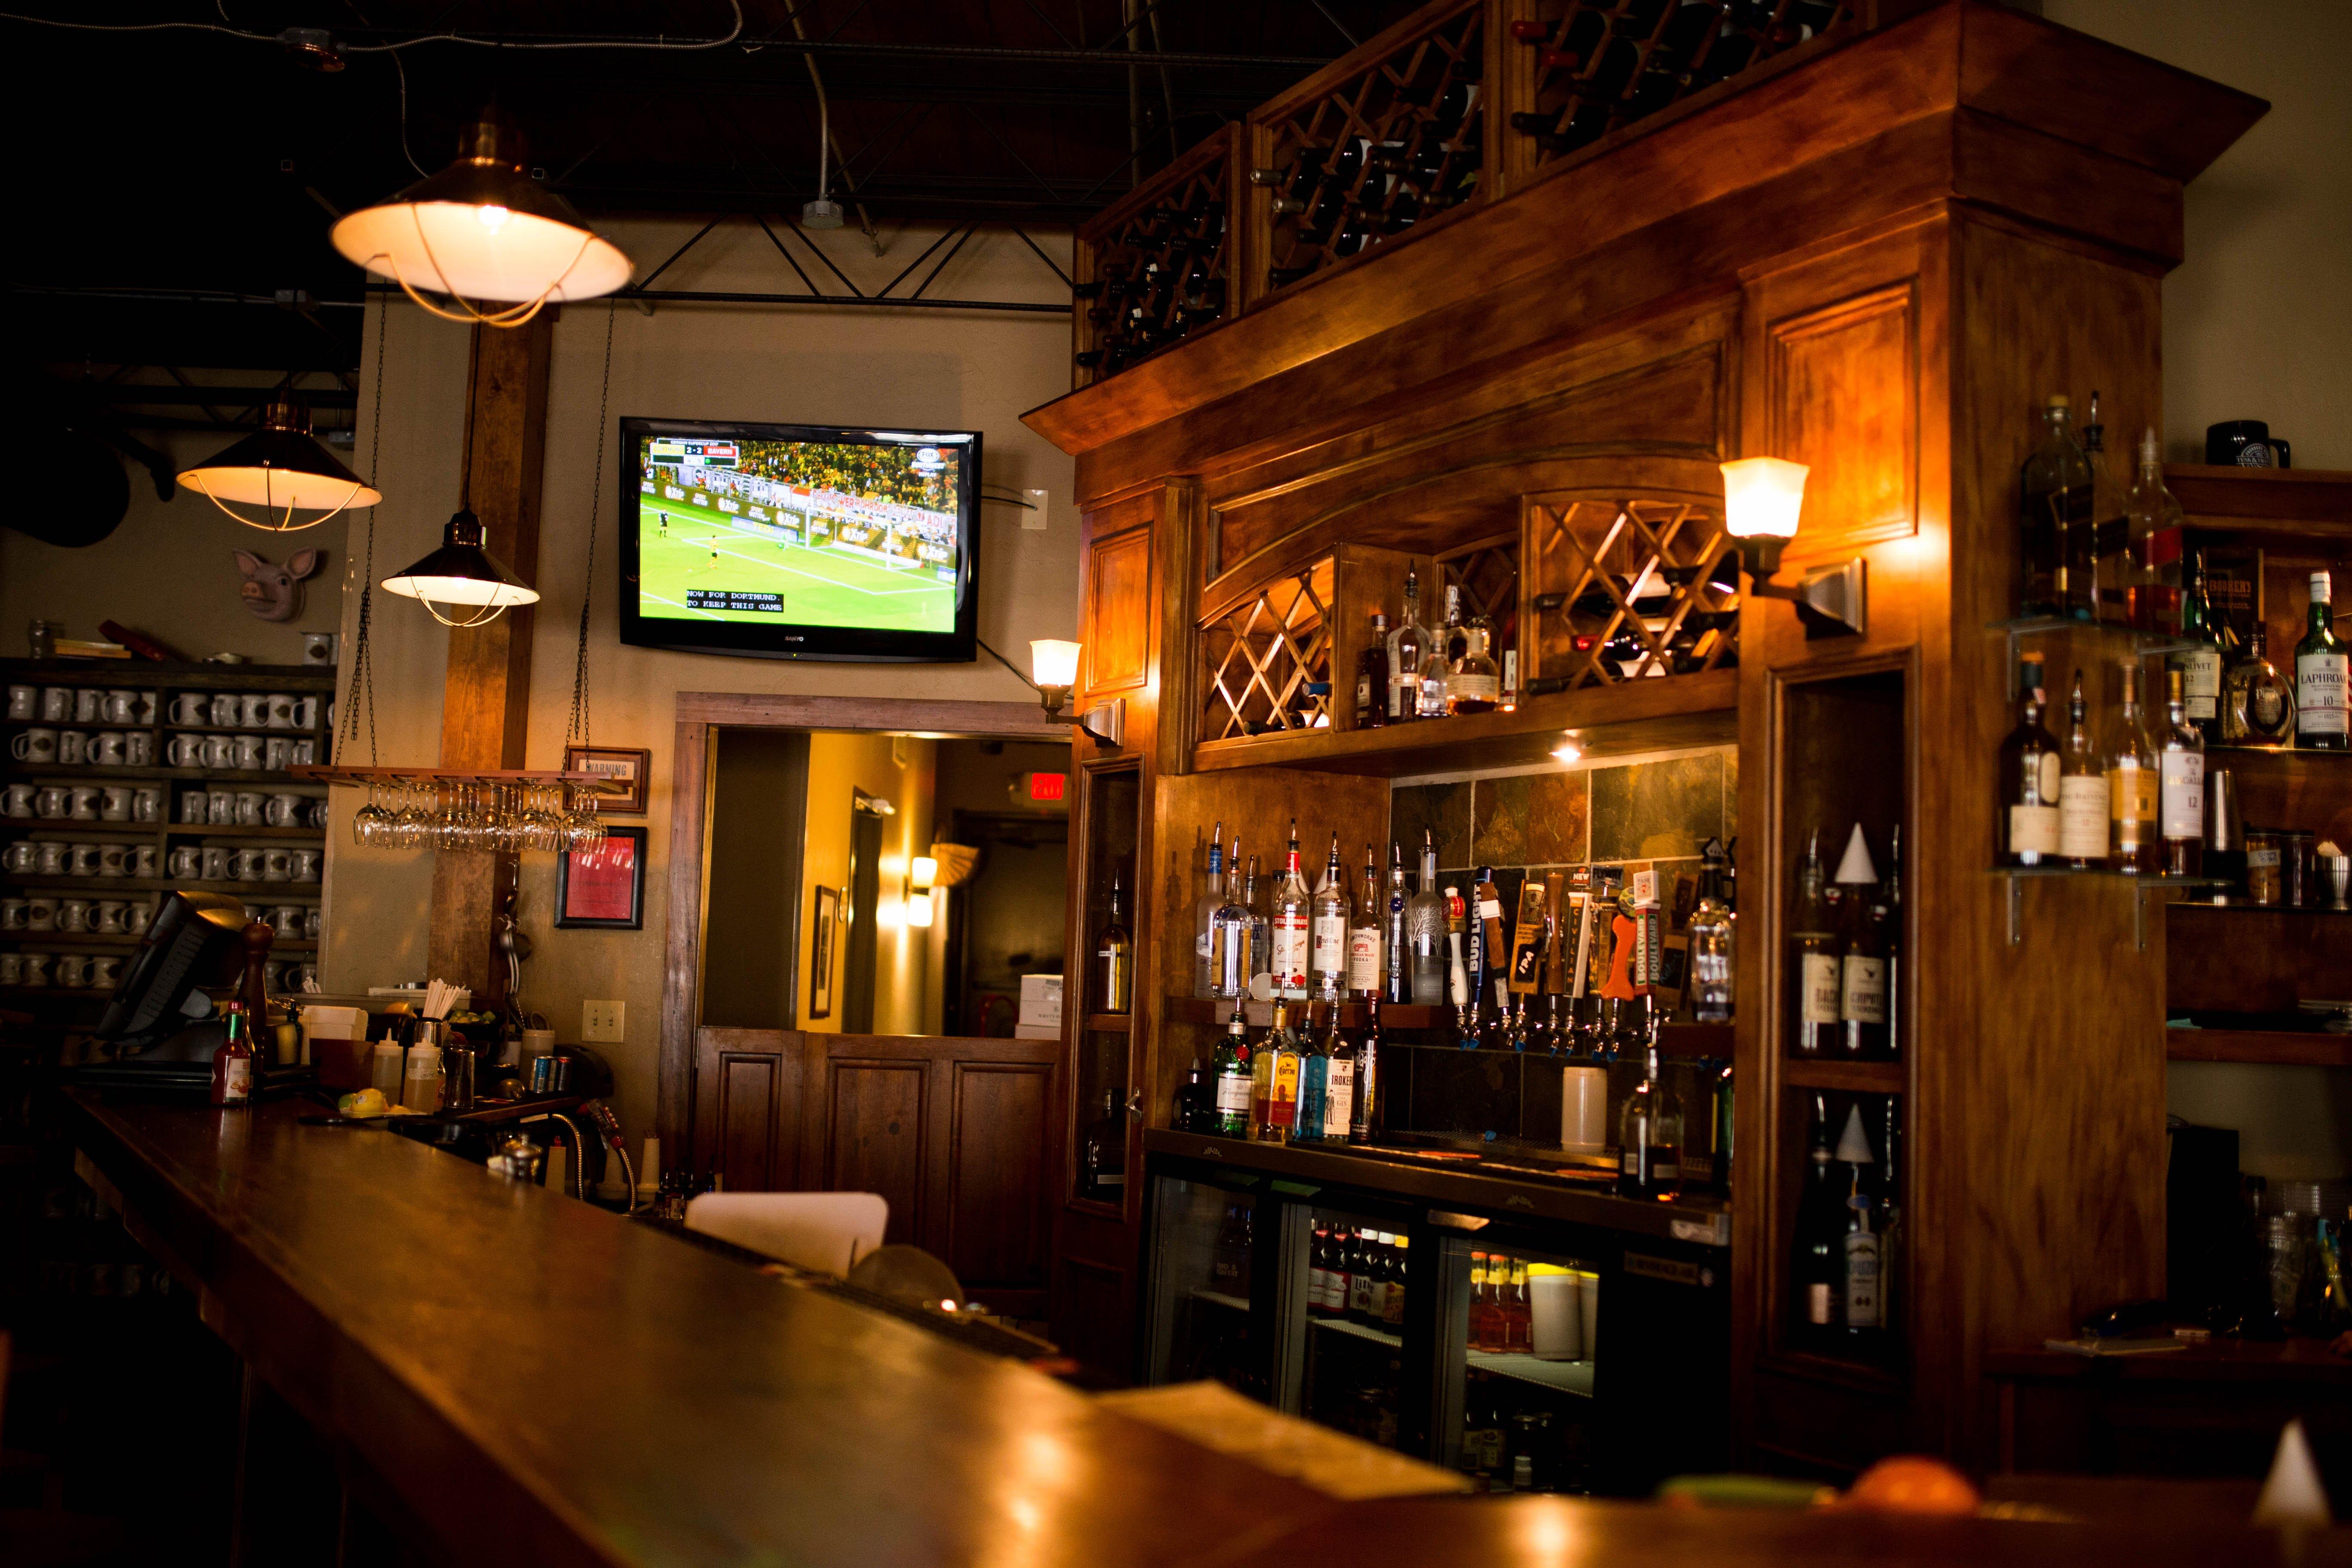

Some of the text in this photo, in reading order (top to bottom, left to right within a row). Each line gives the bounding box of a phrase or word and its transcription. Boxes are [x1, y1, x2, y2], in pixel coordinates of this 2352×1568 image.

[2323, 696, 2334, 706] 10
[586, 763, 626, 776] WARNING
[2188, 796, 2198, 808] 12
[1469, 884, 1482, 971] BUD LIGHT
[1350, 933, 1376, 943] SMITHWORKS
[1567, 909, 1579, 983] CIVILIAN
[1649, 918, 1658, 981] BOULEVARD
[1519, 951, 1534, 974] IPA
[1279, 1066, 1295, 1076] Cuervo
